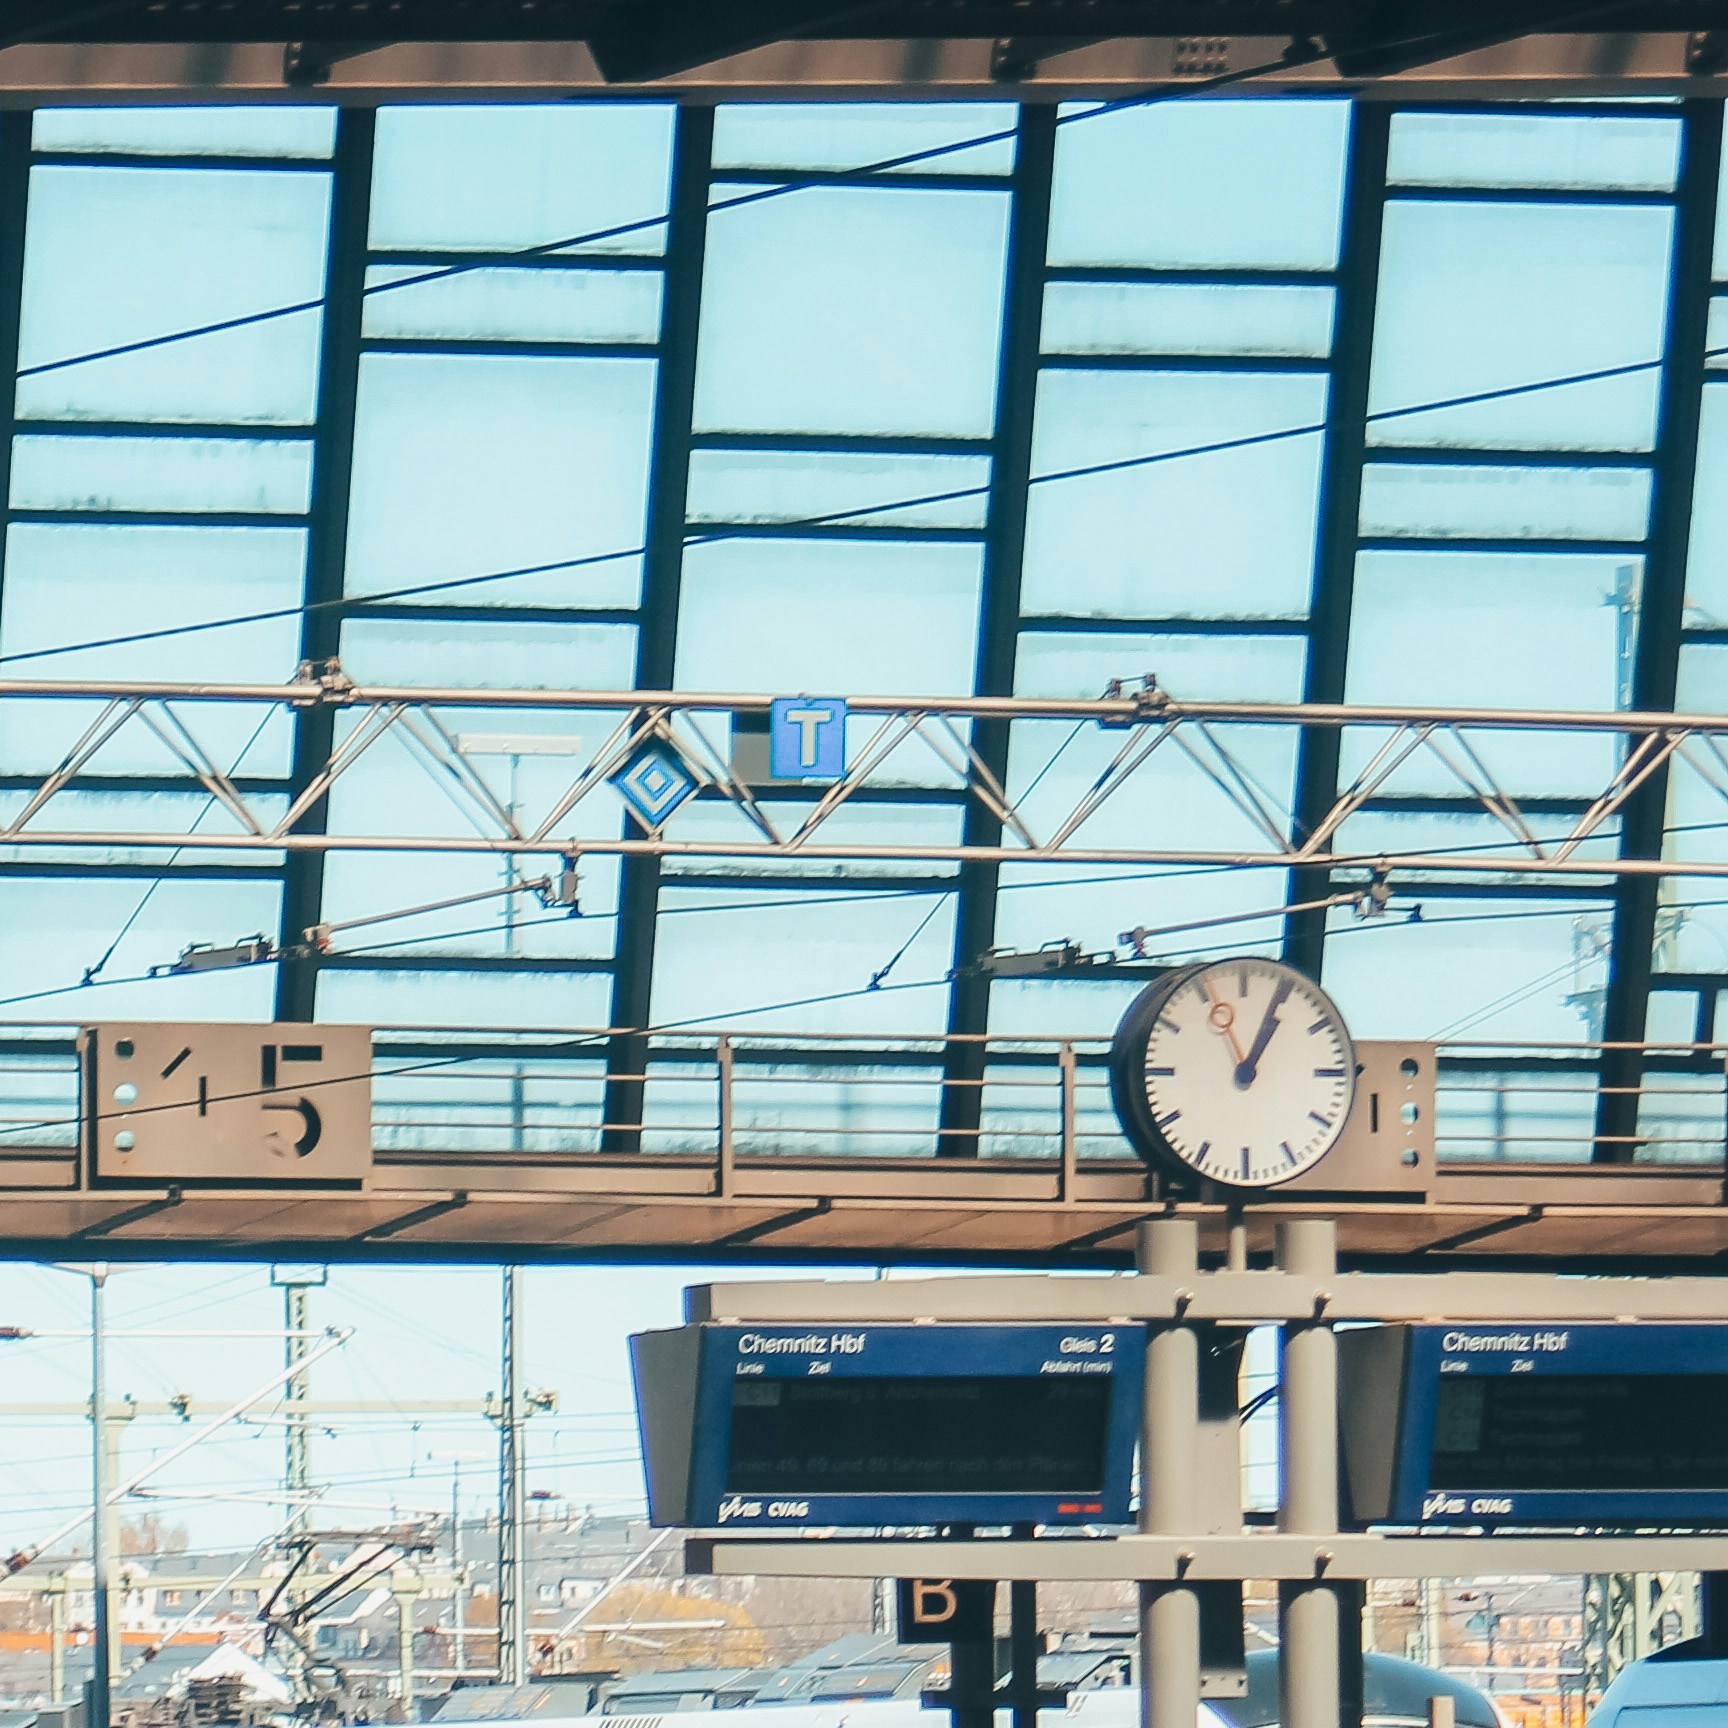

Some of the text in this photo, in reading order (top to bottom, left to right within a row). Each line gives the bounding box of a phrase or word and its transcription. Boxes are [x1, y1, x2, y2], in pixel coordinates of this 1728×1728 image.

[785, 709, 833, 768] T
[260, 1044, 323, 1159] 5
[738, 1332, 867, 1354] Chemnitz Hbf
[1099, 1333, 1116, 1353] 2
[1442, 1331, 1570, 1353] Chemnitz Hbf
[767, 1501, 810, 1518] CVAG
[912, 1578, 957, 1624] B
